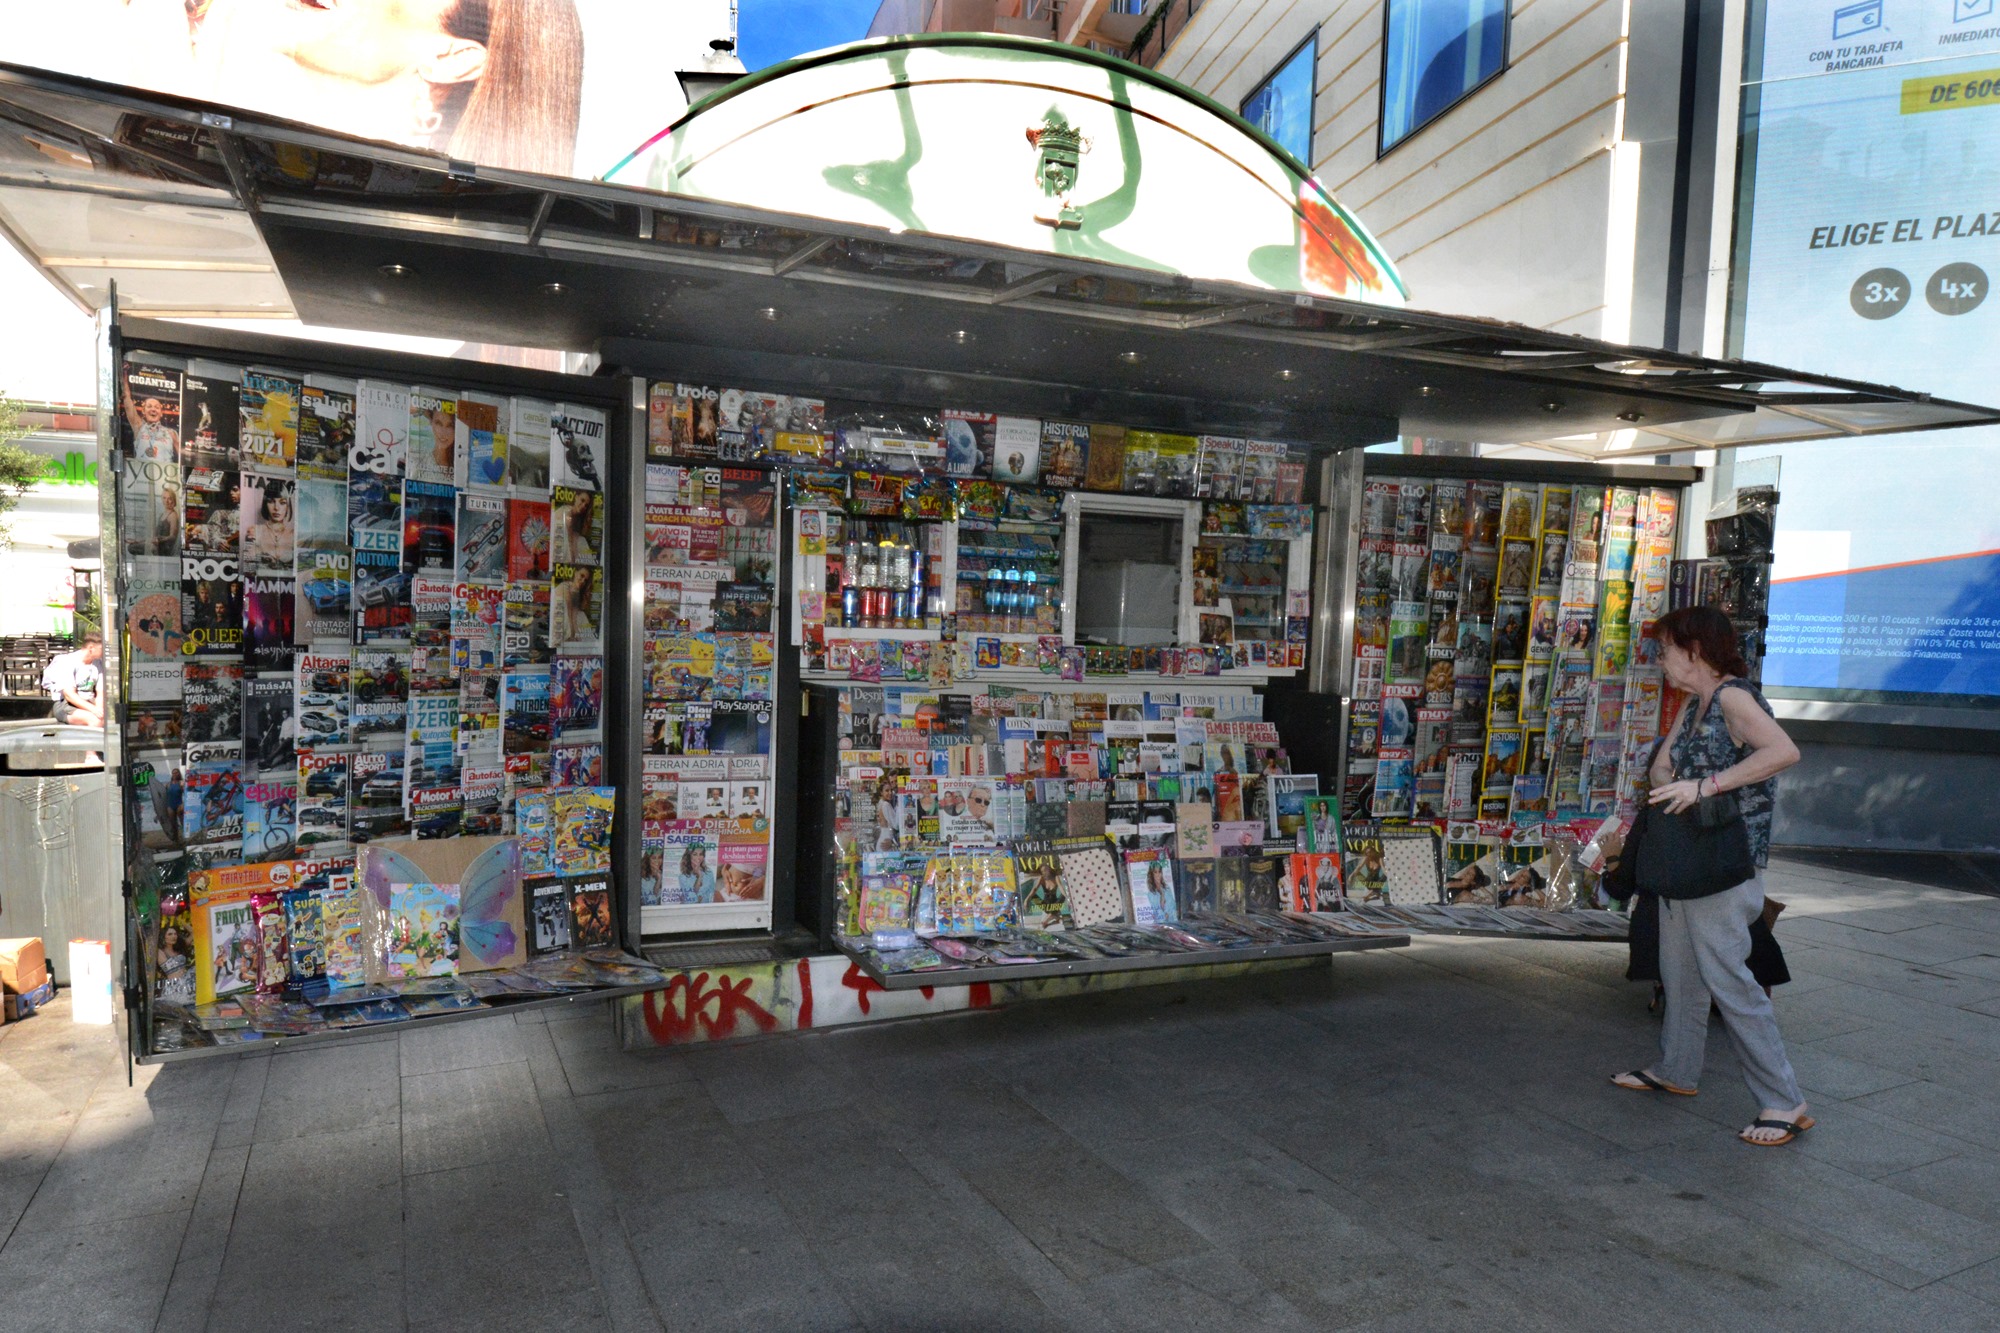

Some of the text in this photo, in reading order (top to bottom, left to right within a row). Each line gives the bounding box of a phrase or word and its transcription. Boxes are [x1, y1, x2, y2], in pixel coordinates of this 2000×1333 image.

[1808, 40, 1904, 63] CON TU TARJETA
[1825, 55, 1885, 72] BANCARIA
[1929, 84, 1961, 104] DE
[1808, 221, 1889, 250] ELIGE
[1891, 218, 1924, 243] EL
[1863, 278, 1977, 304] 3x 4x
[128, 374, 177, 391] GIGANTES
[301, 394, 354, 414] salud
[1043, 421, 1090, 439] HISTORIA
[242, 433, 285, 457] 2021
[722, 468, 762, 481] BEEF!
[652, 514, 680, 523] COACH
[680, 516, 698, 524] PAZ
[674, 508, 684, 516] EL
[685, 508, 709, 517] LIBRO
[711, 510, 722, 518] DE
[657, 526, 680, 536] viva
[656, 536, 688, 549] vida
[315, 553, 350, 571] evo
[182, 558, 244, 583] ROC
[650, 567, 728, 581] FERRAN ADRIA
[722, 592, 768, 601] IMPERIUM
[1359, 595, 1388, 607] ART
[415, 602, 450, 613] VERANO
[1794, 612, 1843, 624] financiación
[1843, 614, 1860, 623] 300
[1880, 615, 1892, 624] 10
[1935, 617, 1960, 626] cuota
[1961, 617, 1973, 626] de
[1974, 618, 1991, 626] 30€
[1801, 625, 1846, 634] posteriores
[1847, 626, 1858, 634] de
[1859, 626, 1871, 634] 30
[1880, 626, 1904, 635] Plazo
[1907, 627, 1917, 635] 10
[1949, 628, 1975, 637] Coste
[1975, 629, 1995, 638] total
[506, 635, 530, 648] 50
[1797, 635, 1825, 645] (precio
[1826, 636, 1845, 645] total
[1886, 637, 1901, 646] 300
[1913, 638, 1930, 647] TIN
[1929, 639, 1943, 648] 0%
[1944, 639, 1962, 649] TAE
[1795, 647, 1840, 656] aprobación
[1840, 647, 1852, 656] de
[1852, 647, 1874, 657] Oney
[1874, 648, 1912, 659] Servicios
[1912, 649, 1963, 660] Financieros.
[1386, 685, 1423, 697] muy
[714, 700, 764, 713] PlayStation
[647, 759, 725, 770] FERRAN ADRIA
[943, 780, 973, 789] pronto
[1275, 778, 1295, 794] AD
[245, 781, 297, 803] eBike
[420, 788, 451, 803] Motor
[463, 788, 498, 800] VERANO
[644, 821, 661, 831] LA
[685, 819, 741, 829] LA DIETA
[669, 827, 752, 836] QUE DESHINCHA
[666, 834, 706, 845] SABER
[574, 881, 607, 894] X-MEN
